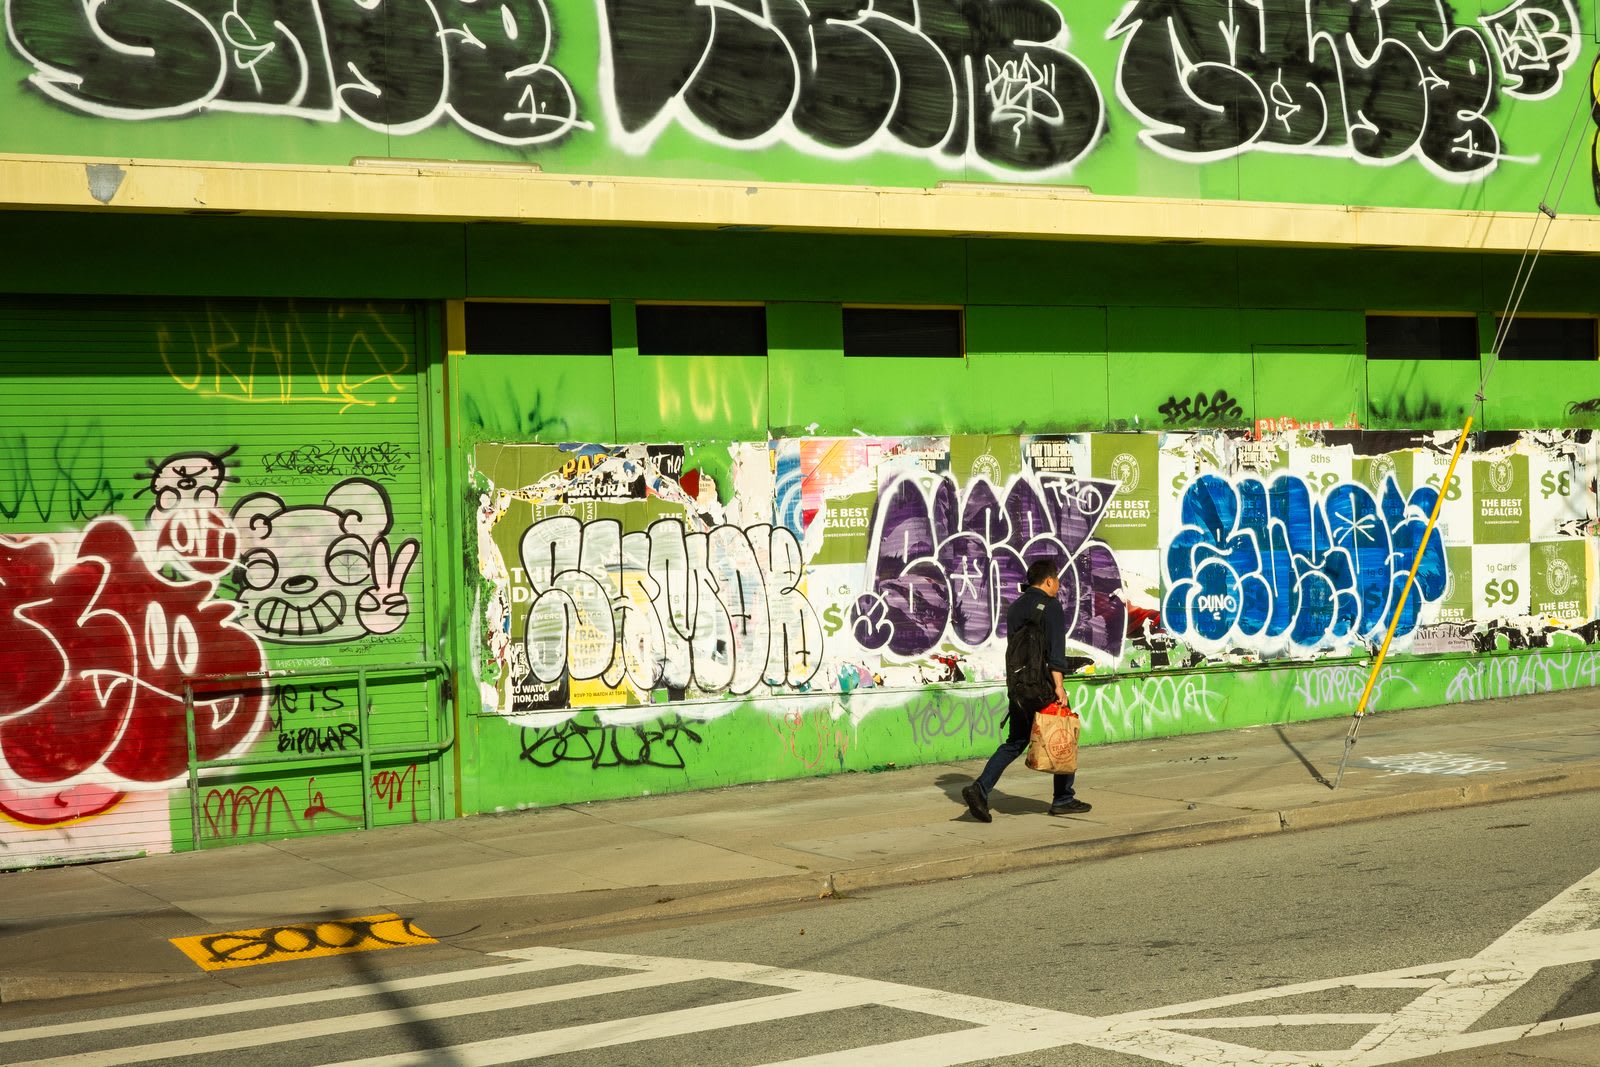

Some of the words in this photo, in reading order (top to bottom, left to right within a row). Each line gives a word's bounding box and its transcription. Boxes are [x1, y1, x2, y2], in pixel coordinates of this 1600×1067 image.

[1310, 454, 1331, 463] 8ths
[1107, 500, 1122, 509] HE
[1124, 500, 1151, 509] BEST
[1481, 498, 1499, 507] THE
[1500, 498, 1522, 507] BEST
[825, 508, 838, 518] HE
[840, 507, 869, 518] BEST
[1481, 507, 1523, 517] DEAL(ER)
[825, 517, 870, 529] EAL(ER)
[1487, 564, 1495, 573] 1g
[1497, 564, 1518, 572] Carts
[1484, 578, 1520, 608] $9
[1539, 602, 1557, 611] THE
[1558, 600, 1580, 610] BEST
[1441, 608, 1465, 617] BEST
[1546, 609, 1581, 619] EAL(ER)
